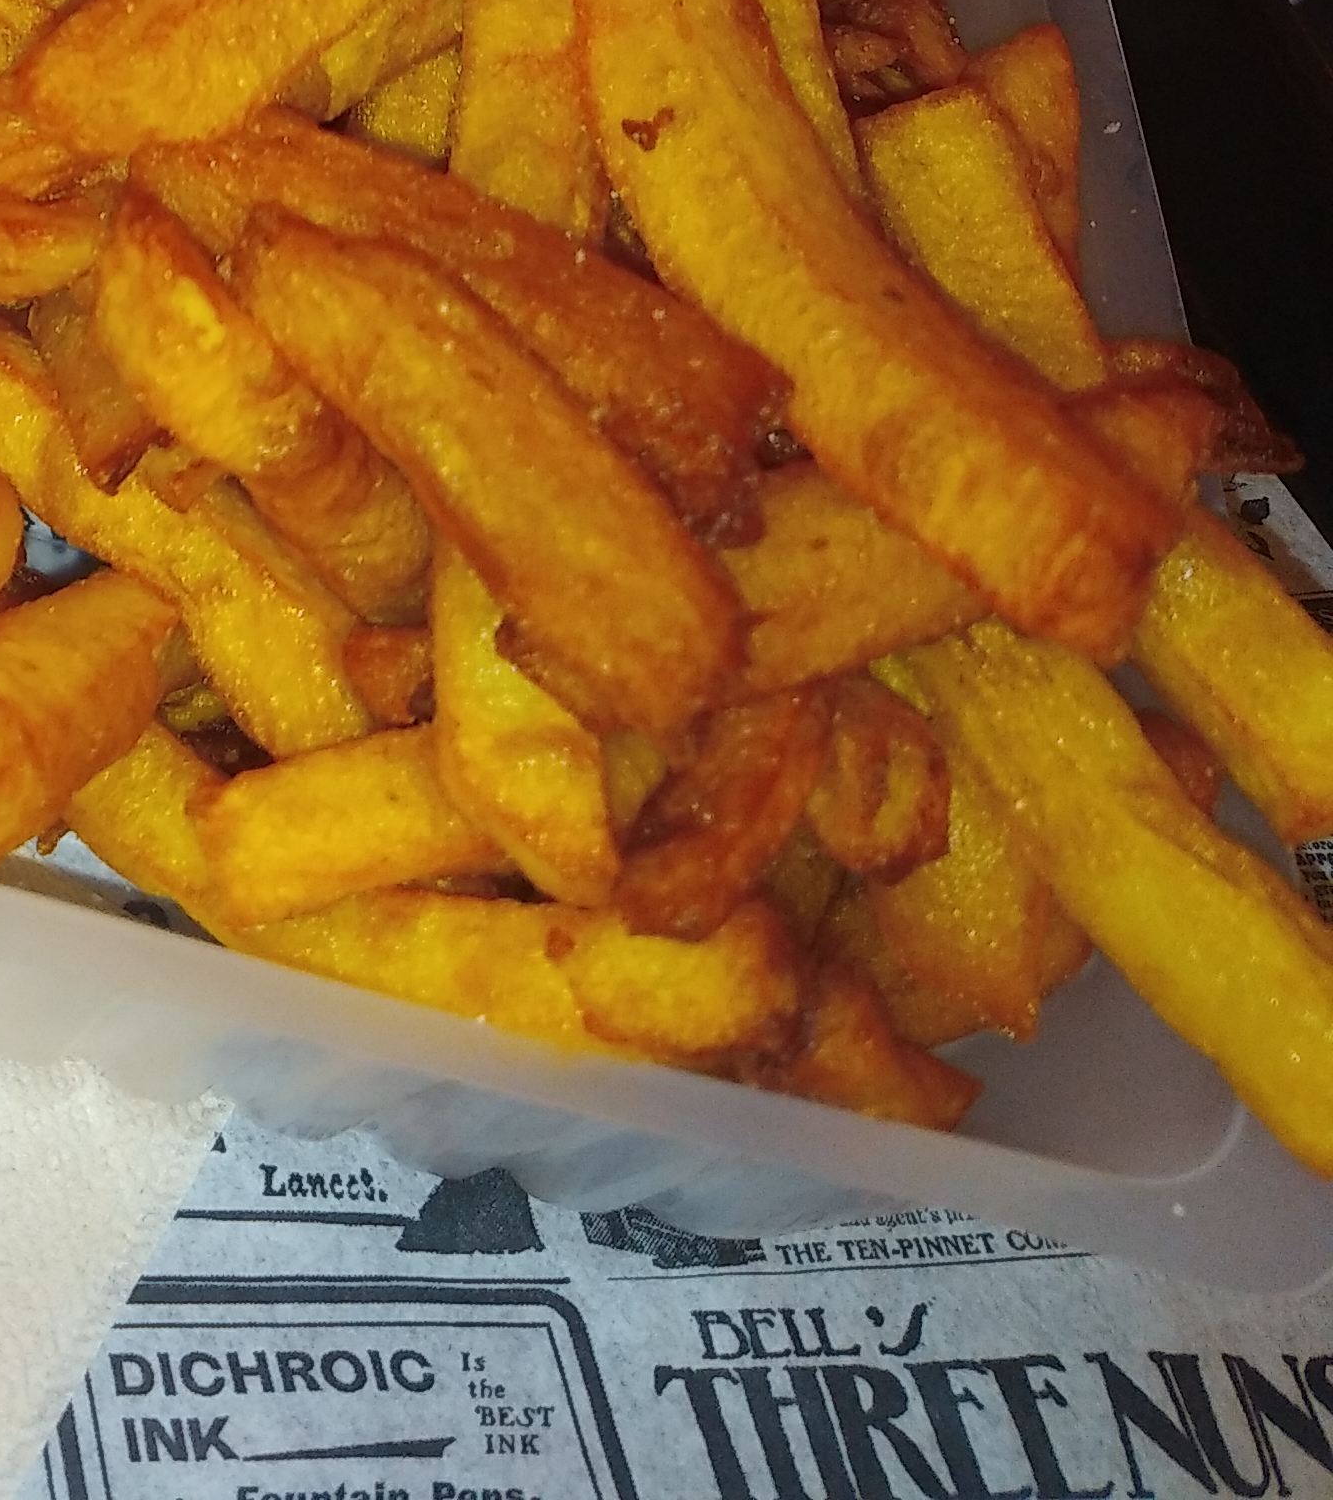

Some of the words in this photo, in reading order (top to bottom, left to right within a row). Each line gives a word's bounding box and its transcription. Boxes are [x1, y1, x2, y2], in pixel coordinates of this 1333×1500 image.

[775, 1241, 833, 1266] THE
[836, 1232, 995, 1262] TEN-PINNET
[691, 1299, 935, 1361] BELL'S
[109, 1348, 436, 1397] DICHROIC
[460, 1351, 486, 1372] Is
[468, 1378, 507, 1400] the
[122, 1415, 241, 1464] INK
[484, 1433, 540, 1456] INK
[653, 1353, 1113, 1500] THREE
